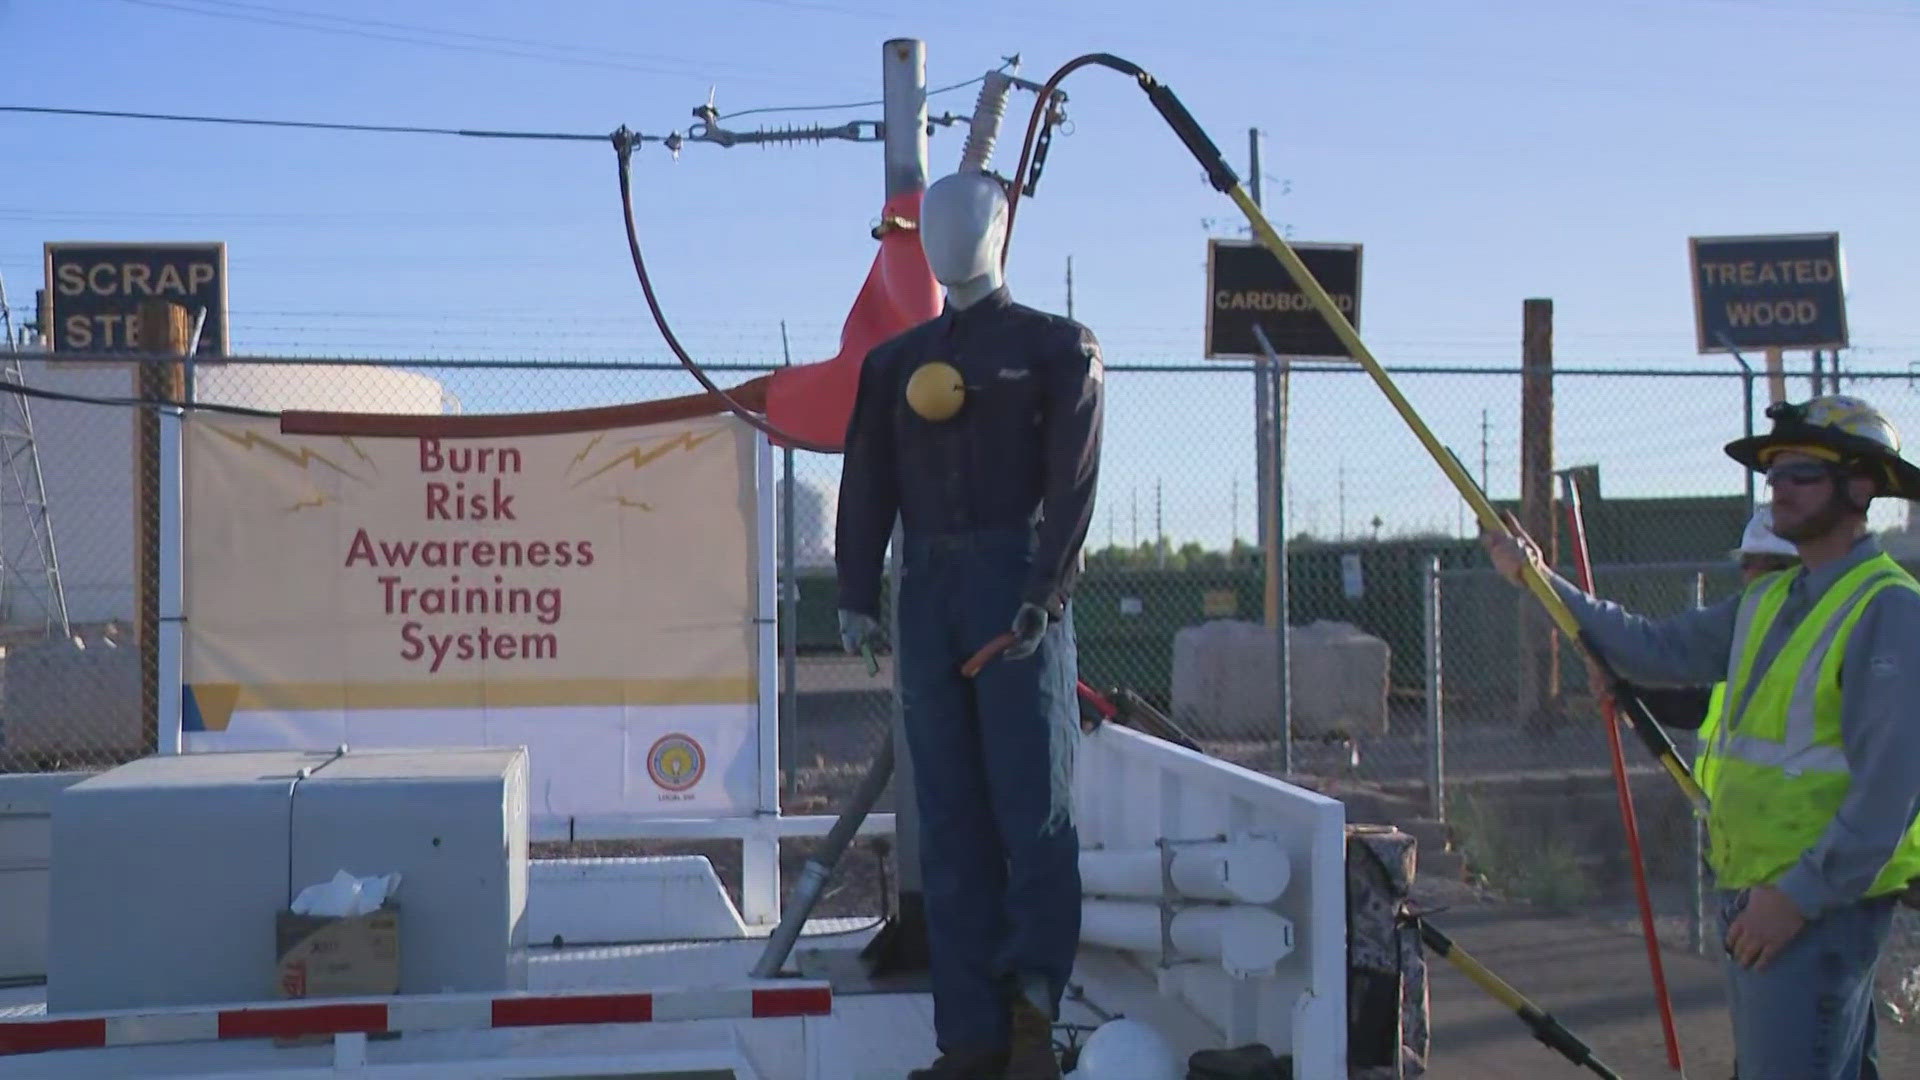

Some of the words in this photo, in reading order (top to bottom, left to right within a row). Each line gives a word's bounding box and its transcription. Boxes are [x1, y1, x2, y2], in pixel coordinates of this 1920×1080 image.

[58, 262, 215, 296] SCRAP
[1701, 259, 1835, 285] TREATED
[1215, 290, 1351, 312] CARDBOD
[1726, 301, 1817, 326] WOOD
[66, 315, 210, 348] STEL
[419, 437, 521, 474] Burn
[426, 478, 516, 520] Risk
[345, 527, 595, 567] Awareness
[378, 575, 562, 625] Training
[400, 621, 557, 673] System
